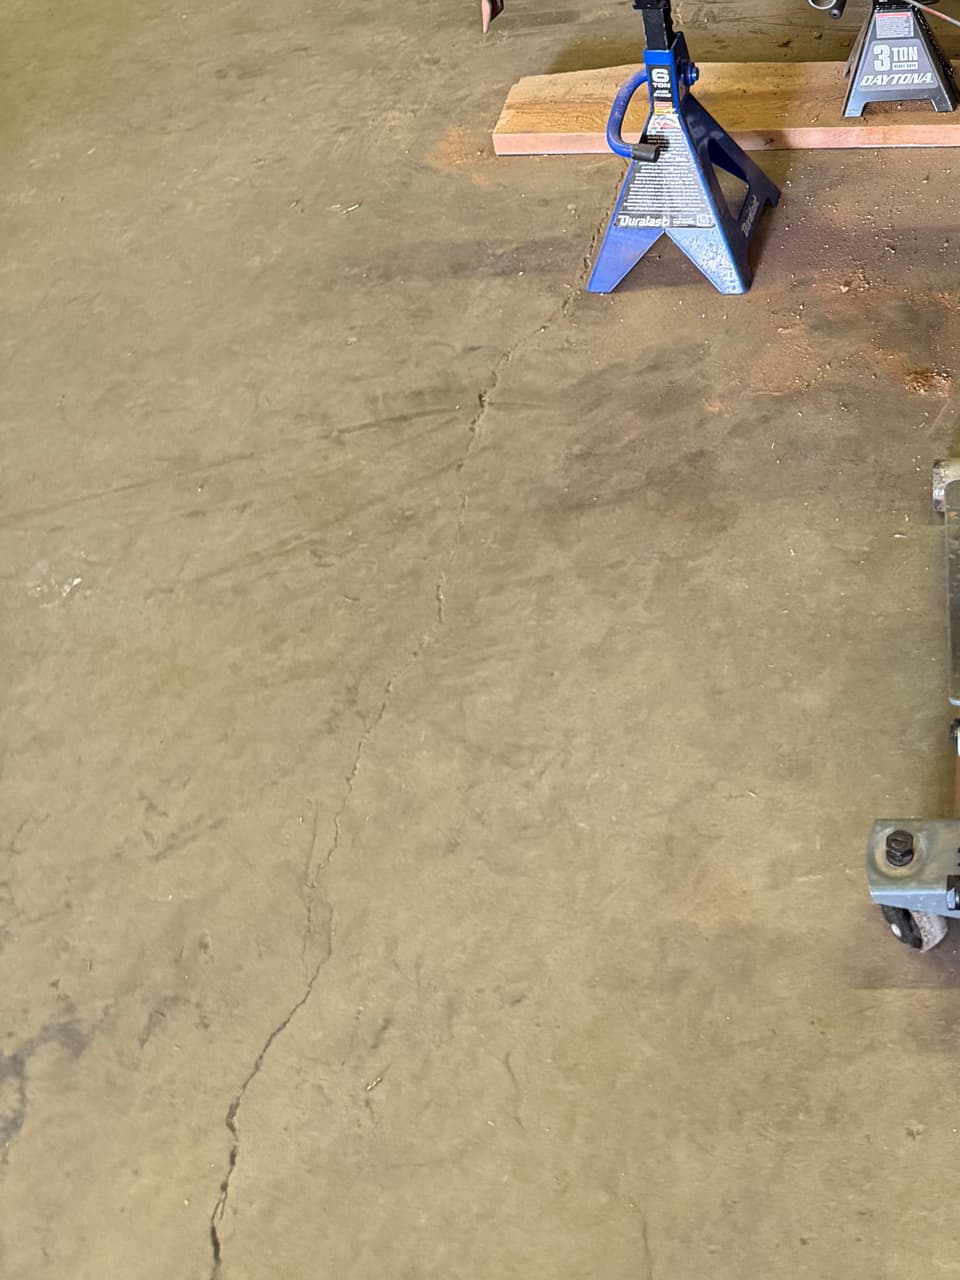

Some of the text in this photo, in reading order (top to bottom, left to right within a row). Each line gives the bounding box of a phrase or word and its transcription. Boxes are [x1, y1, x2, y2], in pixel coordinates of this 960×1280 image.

[873, 45, 919, 72] 3 TON
[651, 68, 670, 83] 6
[859, 72, 935, 87] DAYTONA
[618, 214, 670, 227] Duralast
